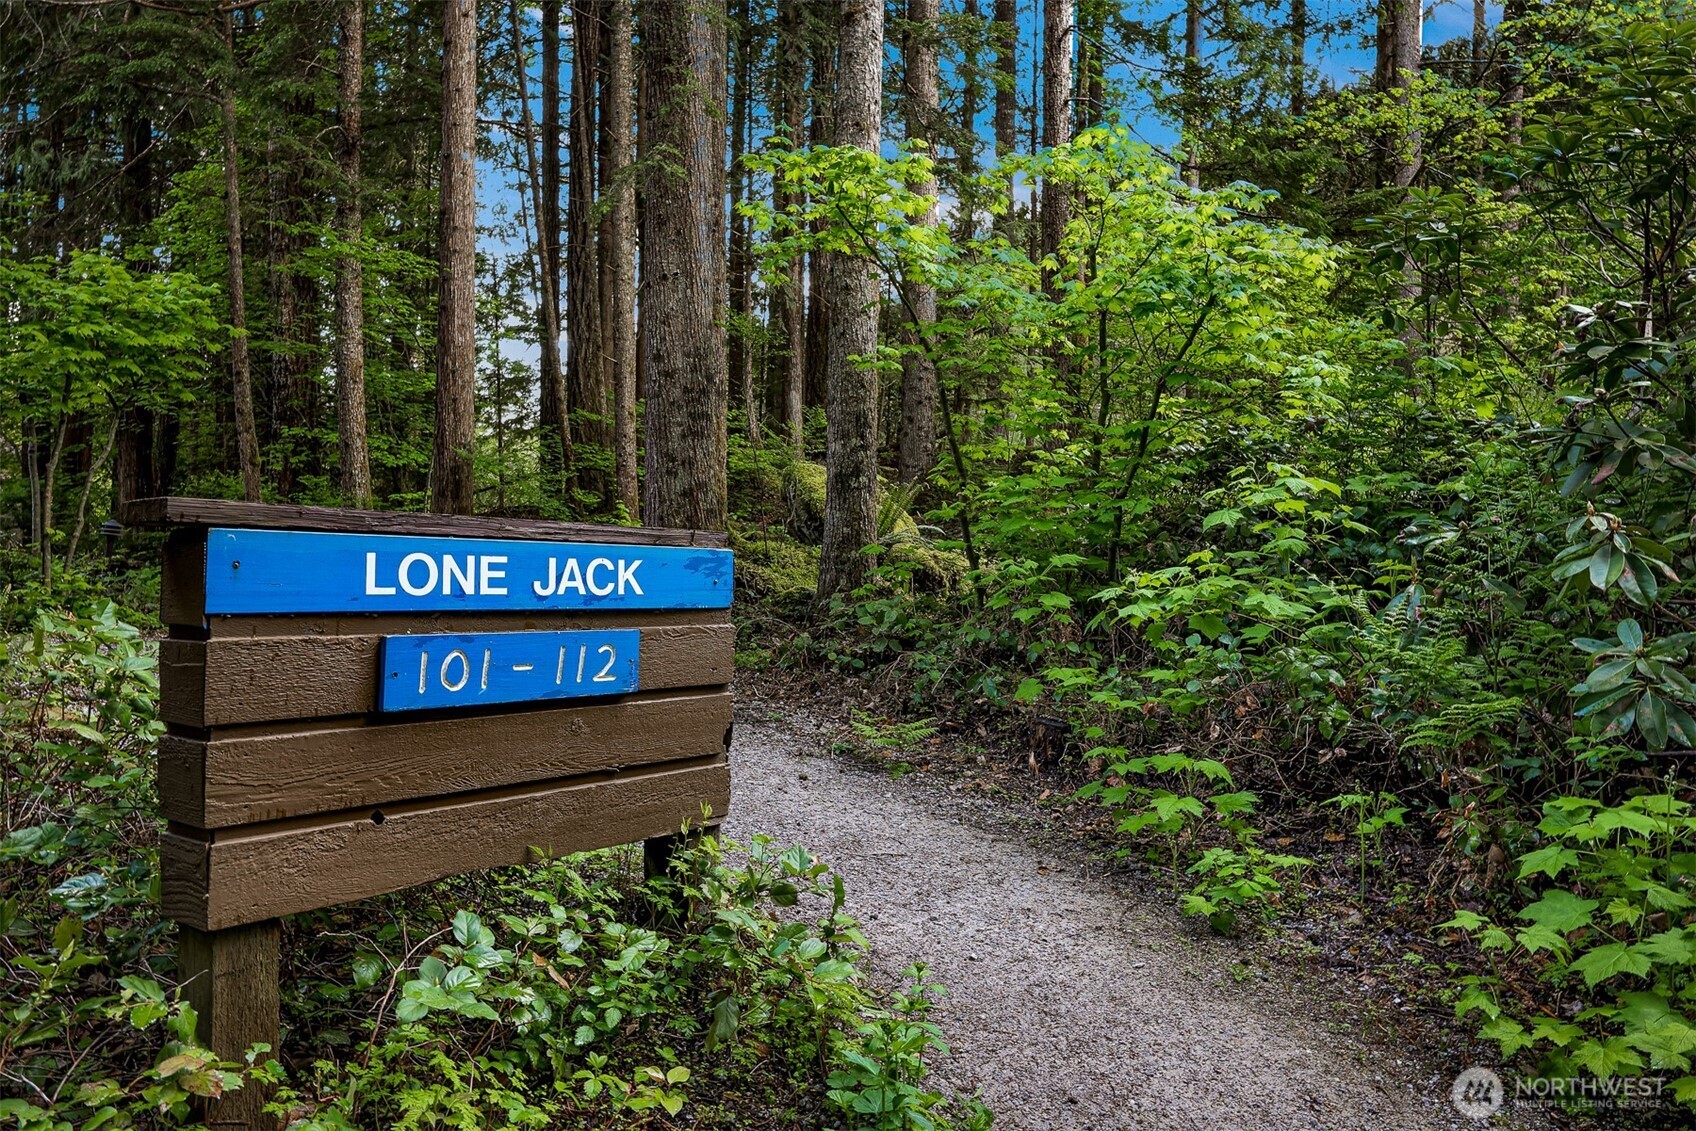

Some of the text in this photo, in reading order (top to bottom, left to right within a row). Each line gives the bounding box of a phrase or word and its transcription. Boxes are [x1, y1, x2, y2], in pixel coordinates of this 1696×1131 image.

[365, 552, 644, 597] LONE JACK
[418, 643, 617, 695] 101 - 112
